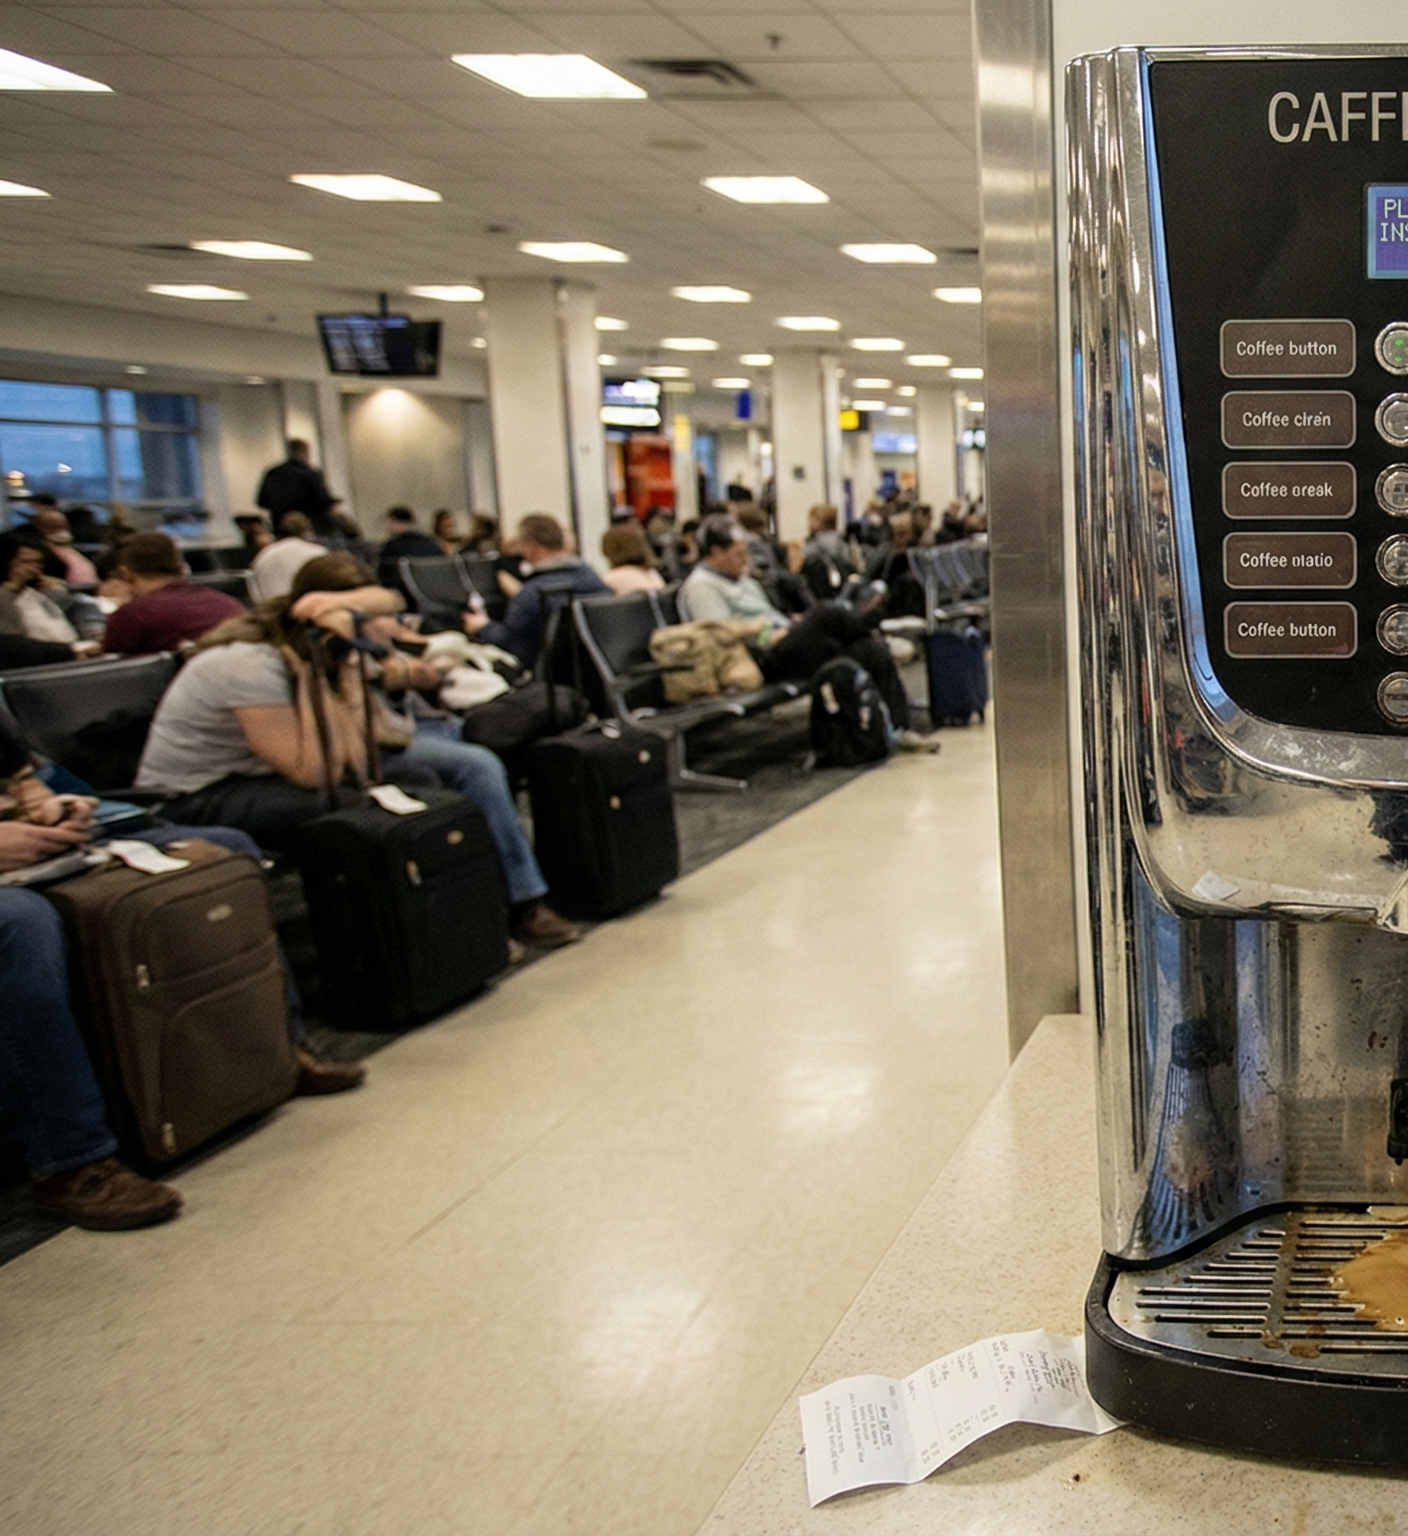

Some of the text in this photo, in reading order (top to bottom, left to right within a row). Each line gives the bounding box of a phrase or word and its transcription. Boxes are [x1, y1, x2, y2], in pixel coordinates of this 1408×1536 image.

[1236, 339, 1337, 356] Coffee button
[1242, 411, 1290, 427] Coffee
[1240, 482, 1288, 498] Coffee
[1239, 552, 1288, 568] Coffee
[1237, 621, 1337, 637] Coffee button
